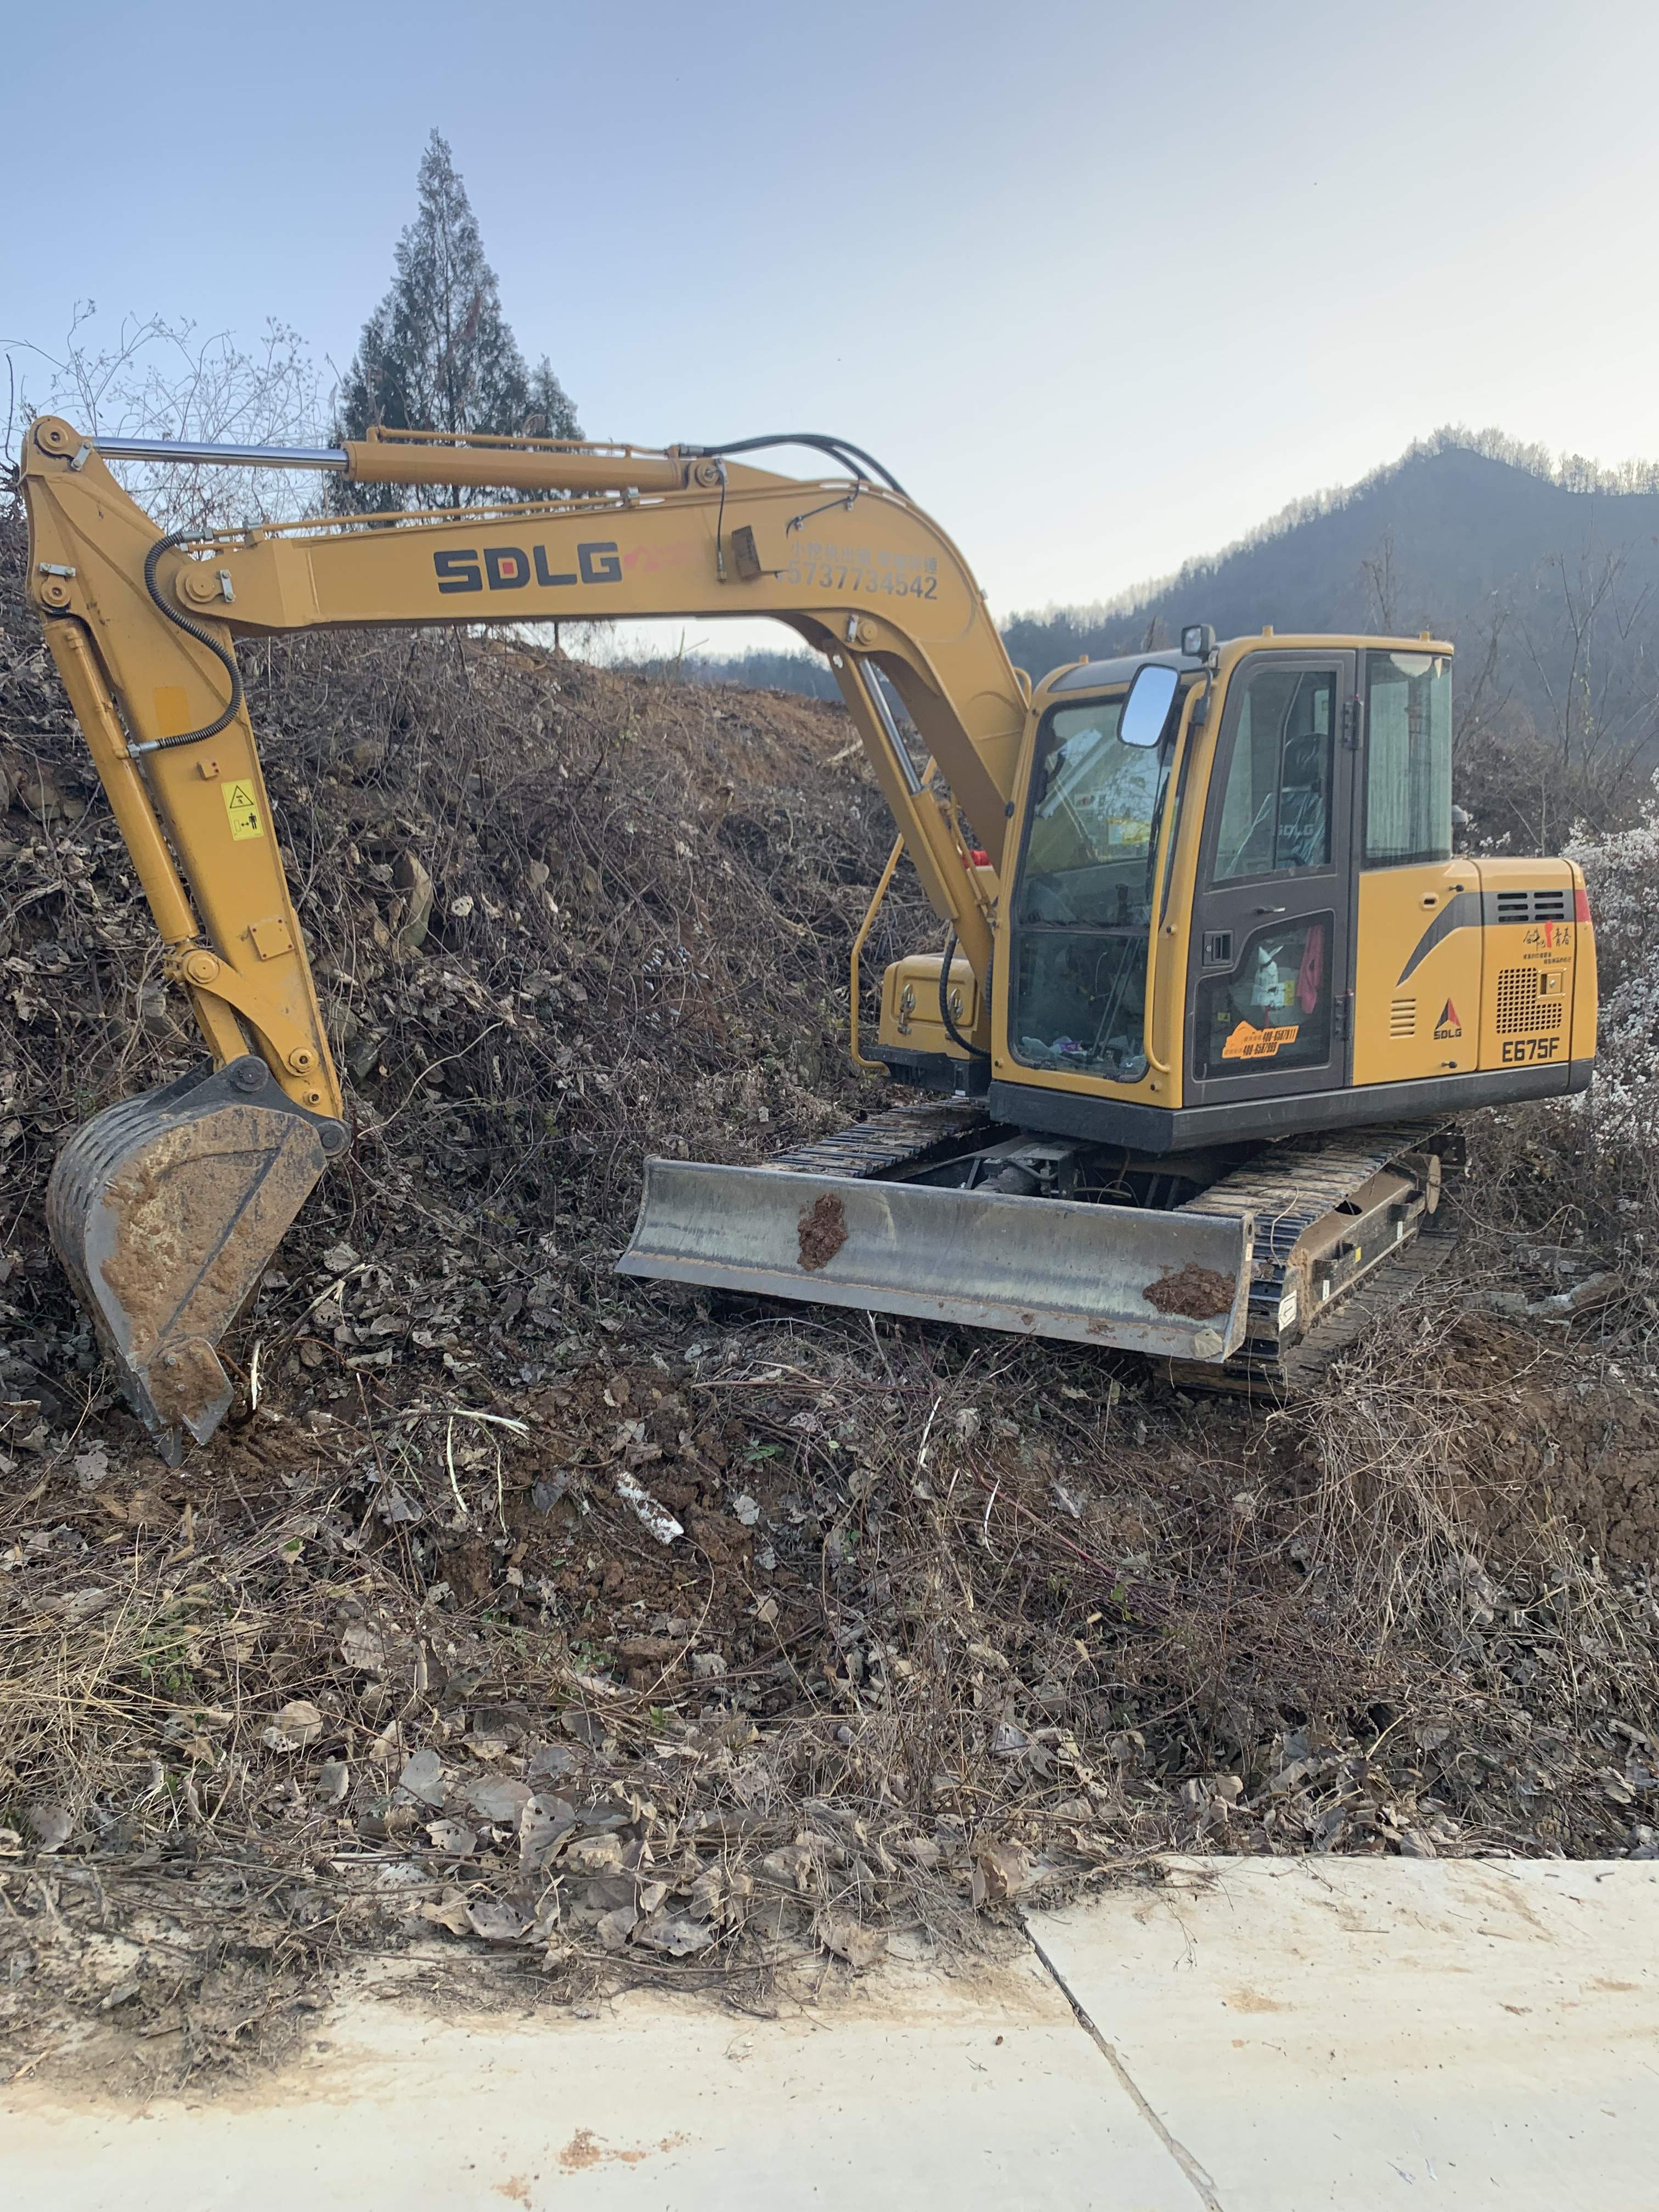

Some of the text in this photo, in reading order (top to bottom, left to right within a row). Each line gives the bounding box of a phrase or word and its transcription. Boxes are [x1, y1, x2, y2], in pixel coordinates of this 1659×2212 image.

[434, 542, 622, 594] SDLG
[1434, 1029, 1462, 1040] SDLG
[1502, 1037, 1560, 1063] E675F
